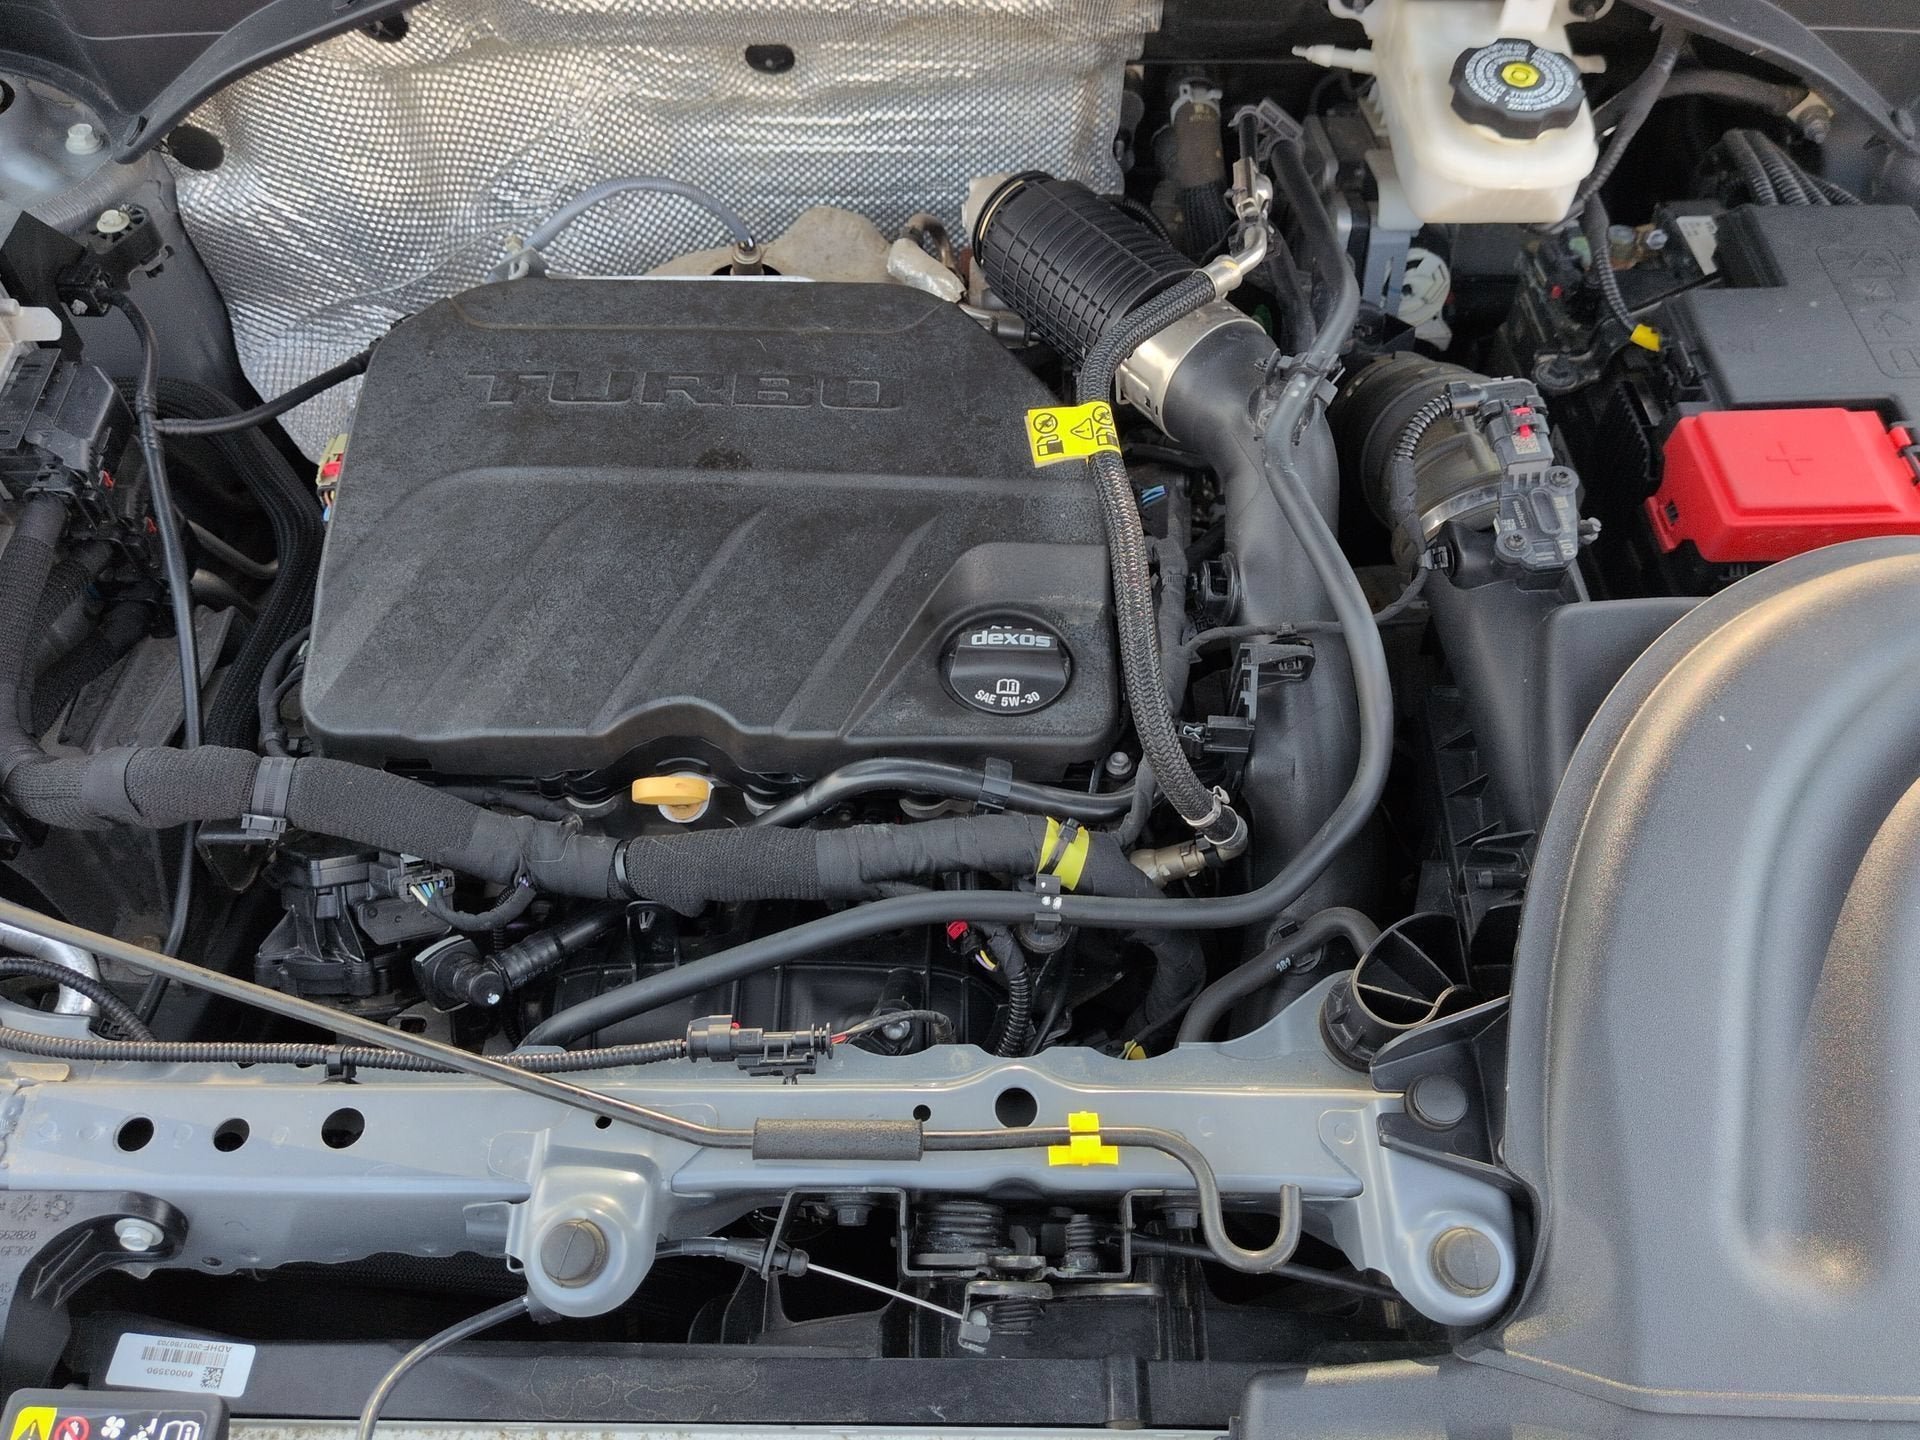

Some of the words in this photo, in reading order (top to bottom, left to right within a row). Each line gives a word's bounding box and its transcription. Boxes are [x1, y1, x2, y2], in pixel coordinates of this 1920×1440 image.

[467, 370, 902, 410] TURBO
[971, 630, 1054, 648] dexos
[974, 689, 997, 705] SAE
[1000, 691, 1040, 707] 5W-30
